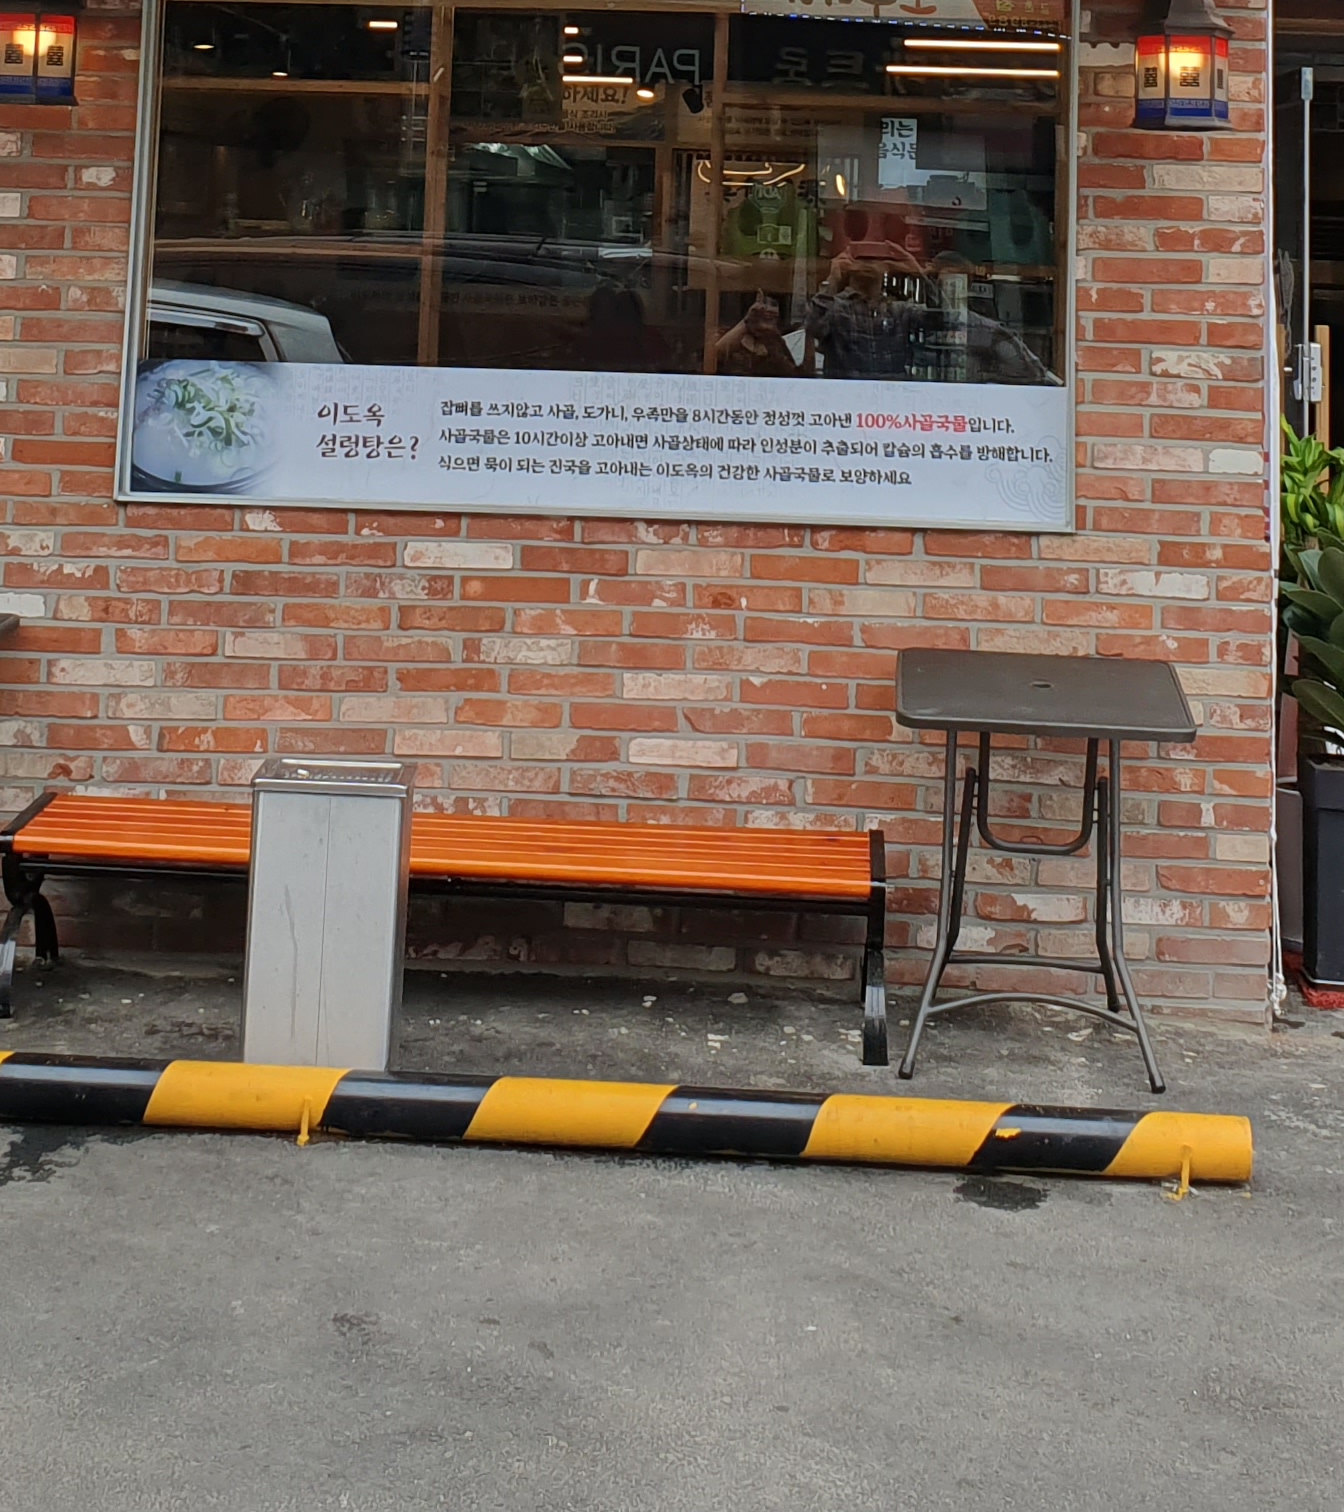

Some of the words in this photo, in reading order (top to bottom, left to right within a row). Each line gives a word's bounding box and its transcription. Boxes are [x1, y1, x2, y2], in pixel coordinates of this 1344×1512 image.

[317, 402, 386, 427] 이도옥
[440, 400, 484, 418] 잡뼈를
[486, 402, 544, 419] 쓰지않고
[547, 404, 580, 421] 사골,
[582, 405, 629, 422] 도가니,
[632, 406, 689, 424] 우족만을
[693, 408, 760, 426] 8시간동안
[762, 410, 806, 427] 정성껏
[808, 413, 853, 428] 고아낸
[856, 413, 1015, 434] 100%사골국물입니다.
[316, 434, 421, 460] 설렁탕은?
[439, 429, 511, 446] 사골국물은
[514, 430, 588, 448] 10시간이상
[591, 433, 649, 449] 고아내면
[653, 435, 724, 452] 사골상태에
[728, 436, 757, 453] 따라
[760, 438, 817, 455] 인성분이
[820, 440, 878, 457] 추출되어
[882, 441, 925, 458] 칼슘의
[929, 443, 973, 461] 흡수를
[976, 445, 1054, 463] 방해합니다.
[438, 455, 481, 472] 식으면
[483, 456, 513, 473] 묵이
[516, 458, 546, 475] 되는
[548, 458, 593, 476] 진국을
[594, 460, 653, 477] 고아내는
[656, 461, 714, 479] 이도옥의
[717, 463, 761, 481] 건강한
[763, 465, 836, 483] 사골국물로
[839, 468, 912, 485] 보양하세요
